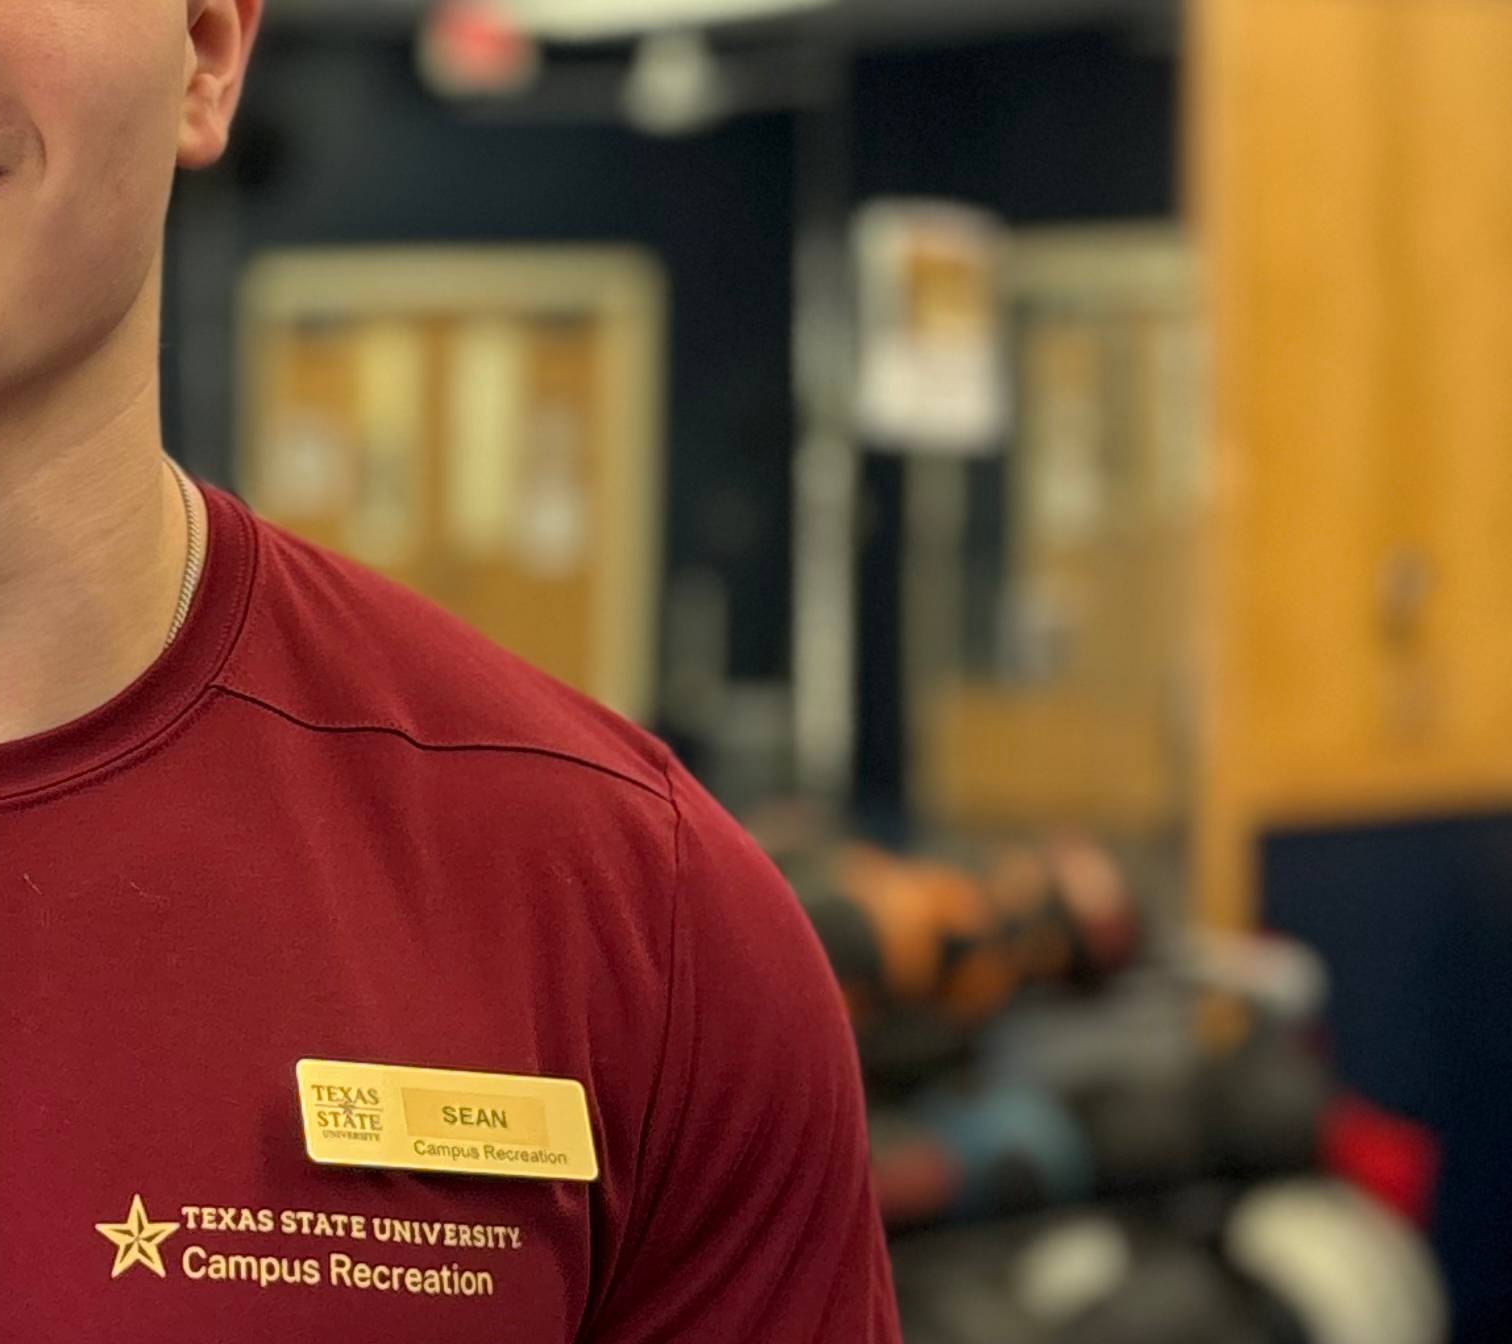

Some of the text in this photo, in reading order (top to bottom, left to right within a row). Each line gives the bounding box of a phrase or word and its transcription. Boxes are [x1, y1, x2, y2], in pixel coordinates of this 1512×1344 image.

[311, 1084, 379, 1105] TEXAS
[317, 1110, 383, 1131] STATE
[441, 1105, 508, 1129] SEAN
[322, 1129, 381, 1142] UNIVERSITY
[413, 1139, 567, 1166] Campus Recreation
[181, 1205, 521, 1249] TEXAS STATE UNIVERSITY
[181, 1245, 493, 1296] Campus Recreation
